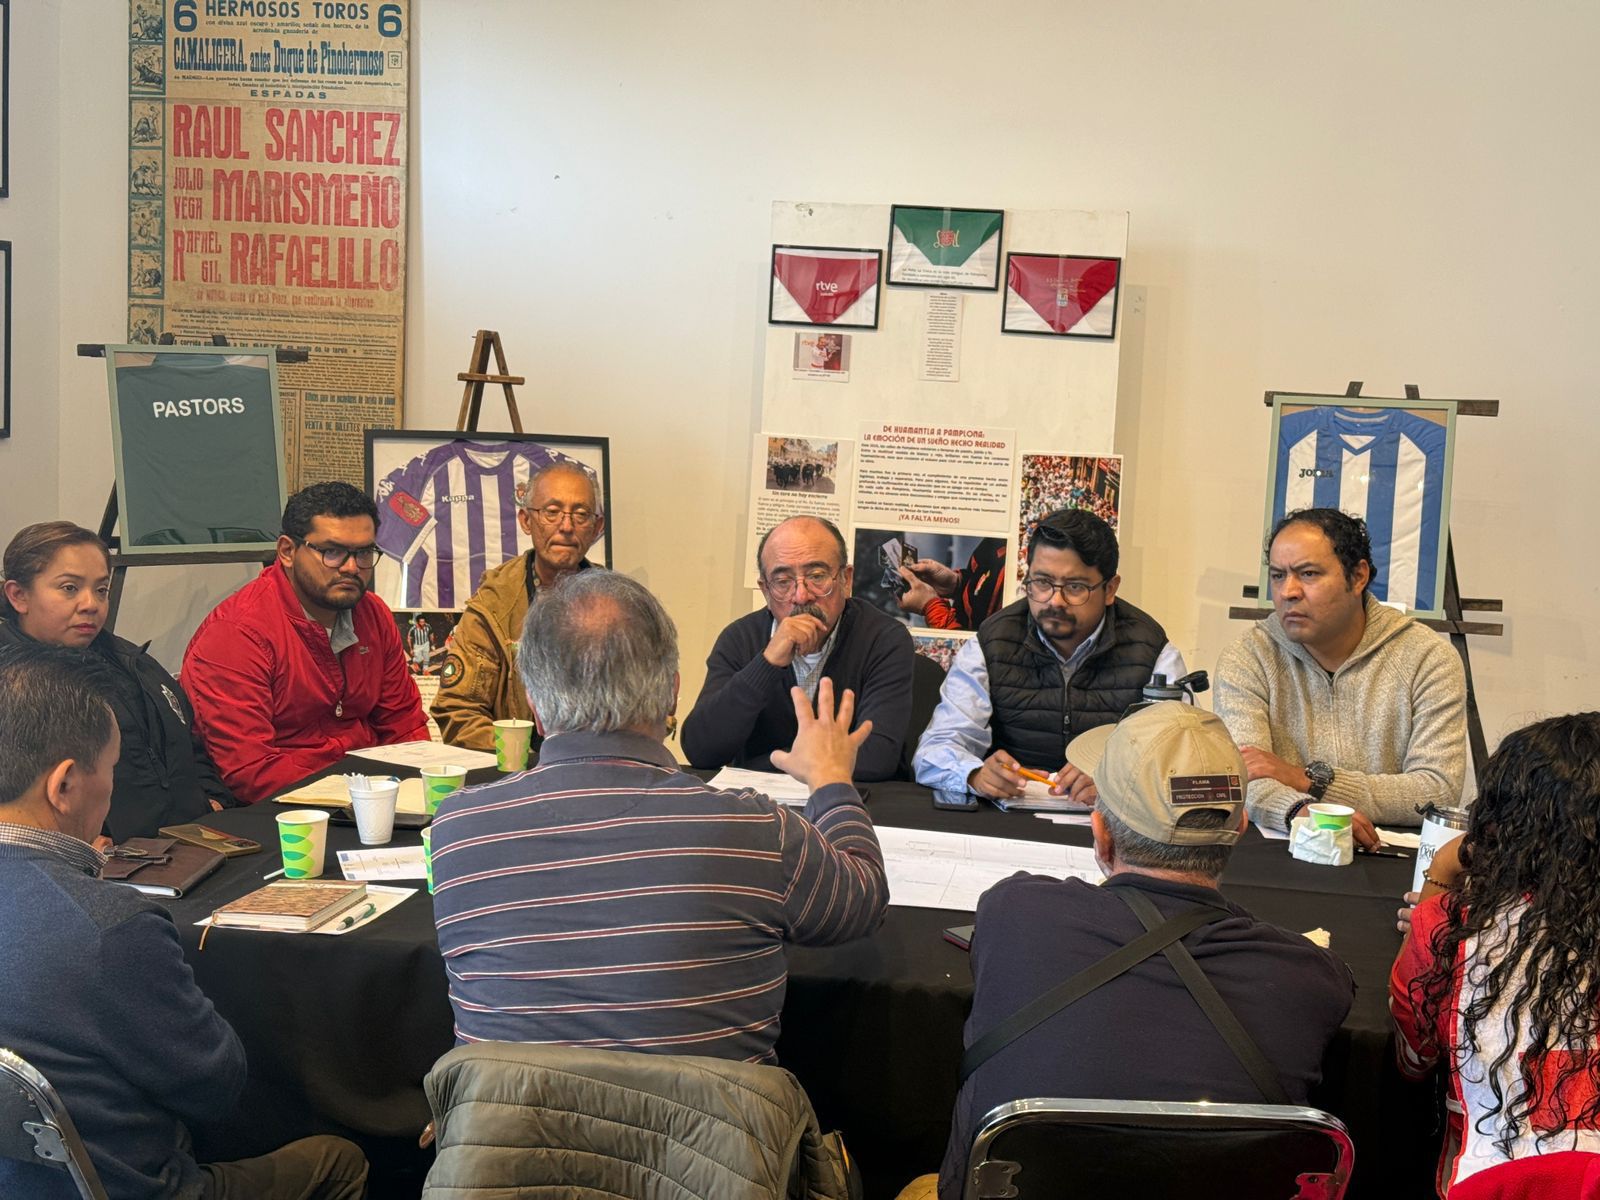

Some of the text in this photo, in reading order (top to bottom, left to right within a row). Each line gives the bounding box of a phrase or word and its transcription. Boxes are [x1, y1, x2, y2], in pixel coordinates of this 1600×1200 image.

[174, 1, 198, 32] 6
[205, 0, 369, 20] HERMOSOS TOROS
[378, 4, 402, 37] 6
[273, 40, 304, 77] Duque
[306, 40, 318, 74] de
[320, 40, 384, 76] Pinohermoso
[250, 90, 327, 99] ESPADAS
[173, 104, 401, 166] RAUL SANCHEZ
[173, 167, 204, 191] JULIO
[212, 168, 400, 229] MARISMEÑO
[201, 260, 222, 284] GIL
[230, 232, 400, 292] RAFAELILLO
[815, 281, 839, 292] rtve
[152, 397, 245, 418] PASTORS
[872, 434, 906, 443] EMOCIÓN
[907, 436, 916, 444] DE
[917, 436, 926, 444] UN
[927, 437, 949, 446] SUEÑO
[951, 439, 974, 447] HECHO
[975, 440, 1006, 449] REALIDAD
[883, 425, 892, 433] DE
[894, 426, 935, 435] HUAMANTLA
[936, 427, 942, 435] A
